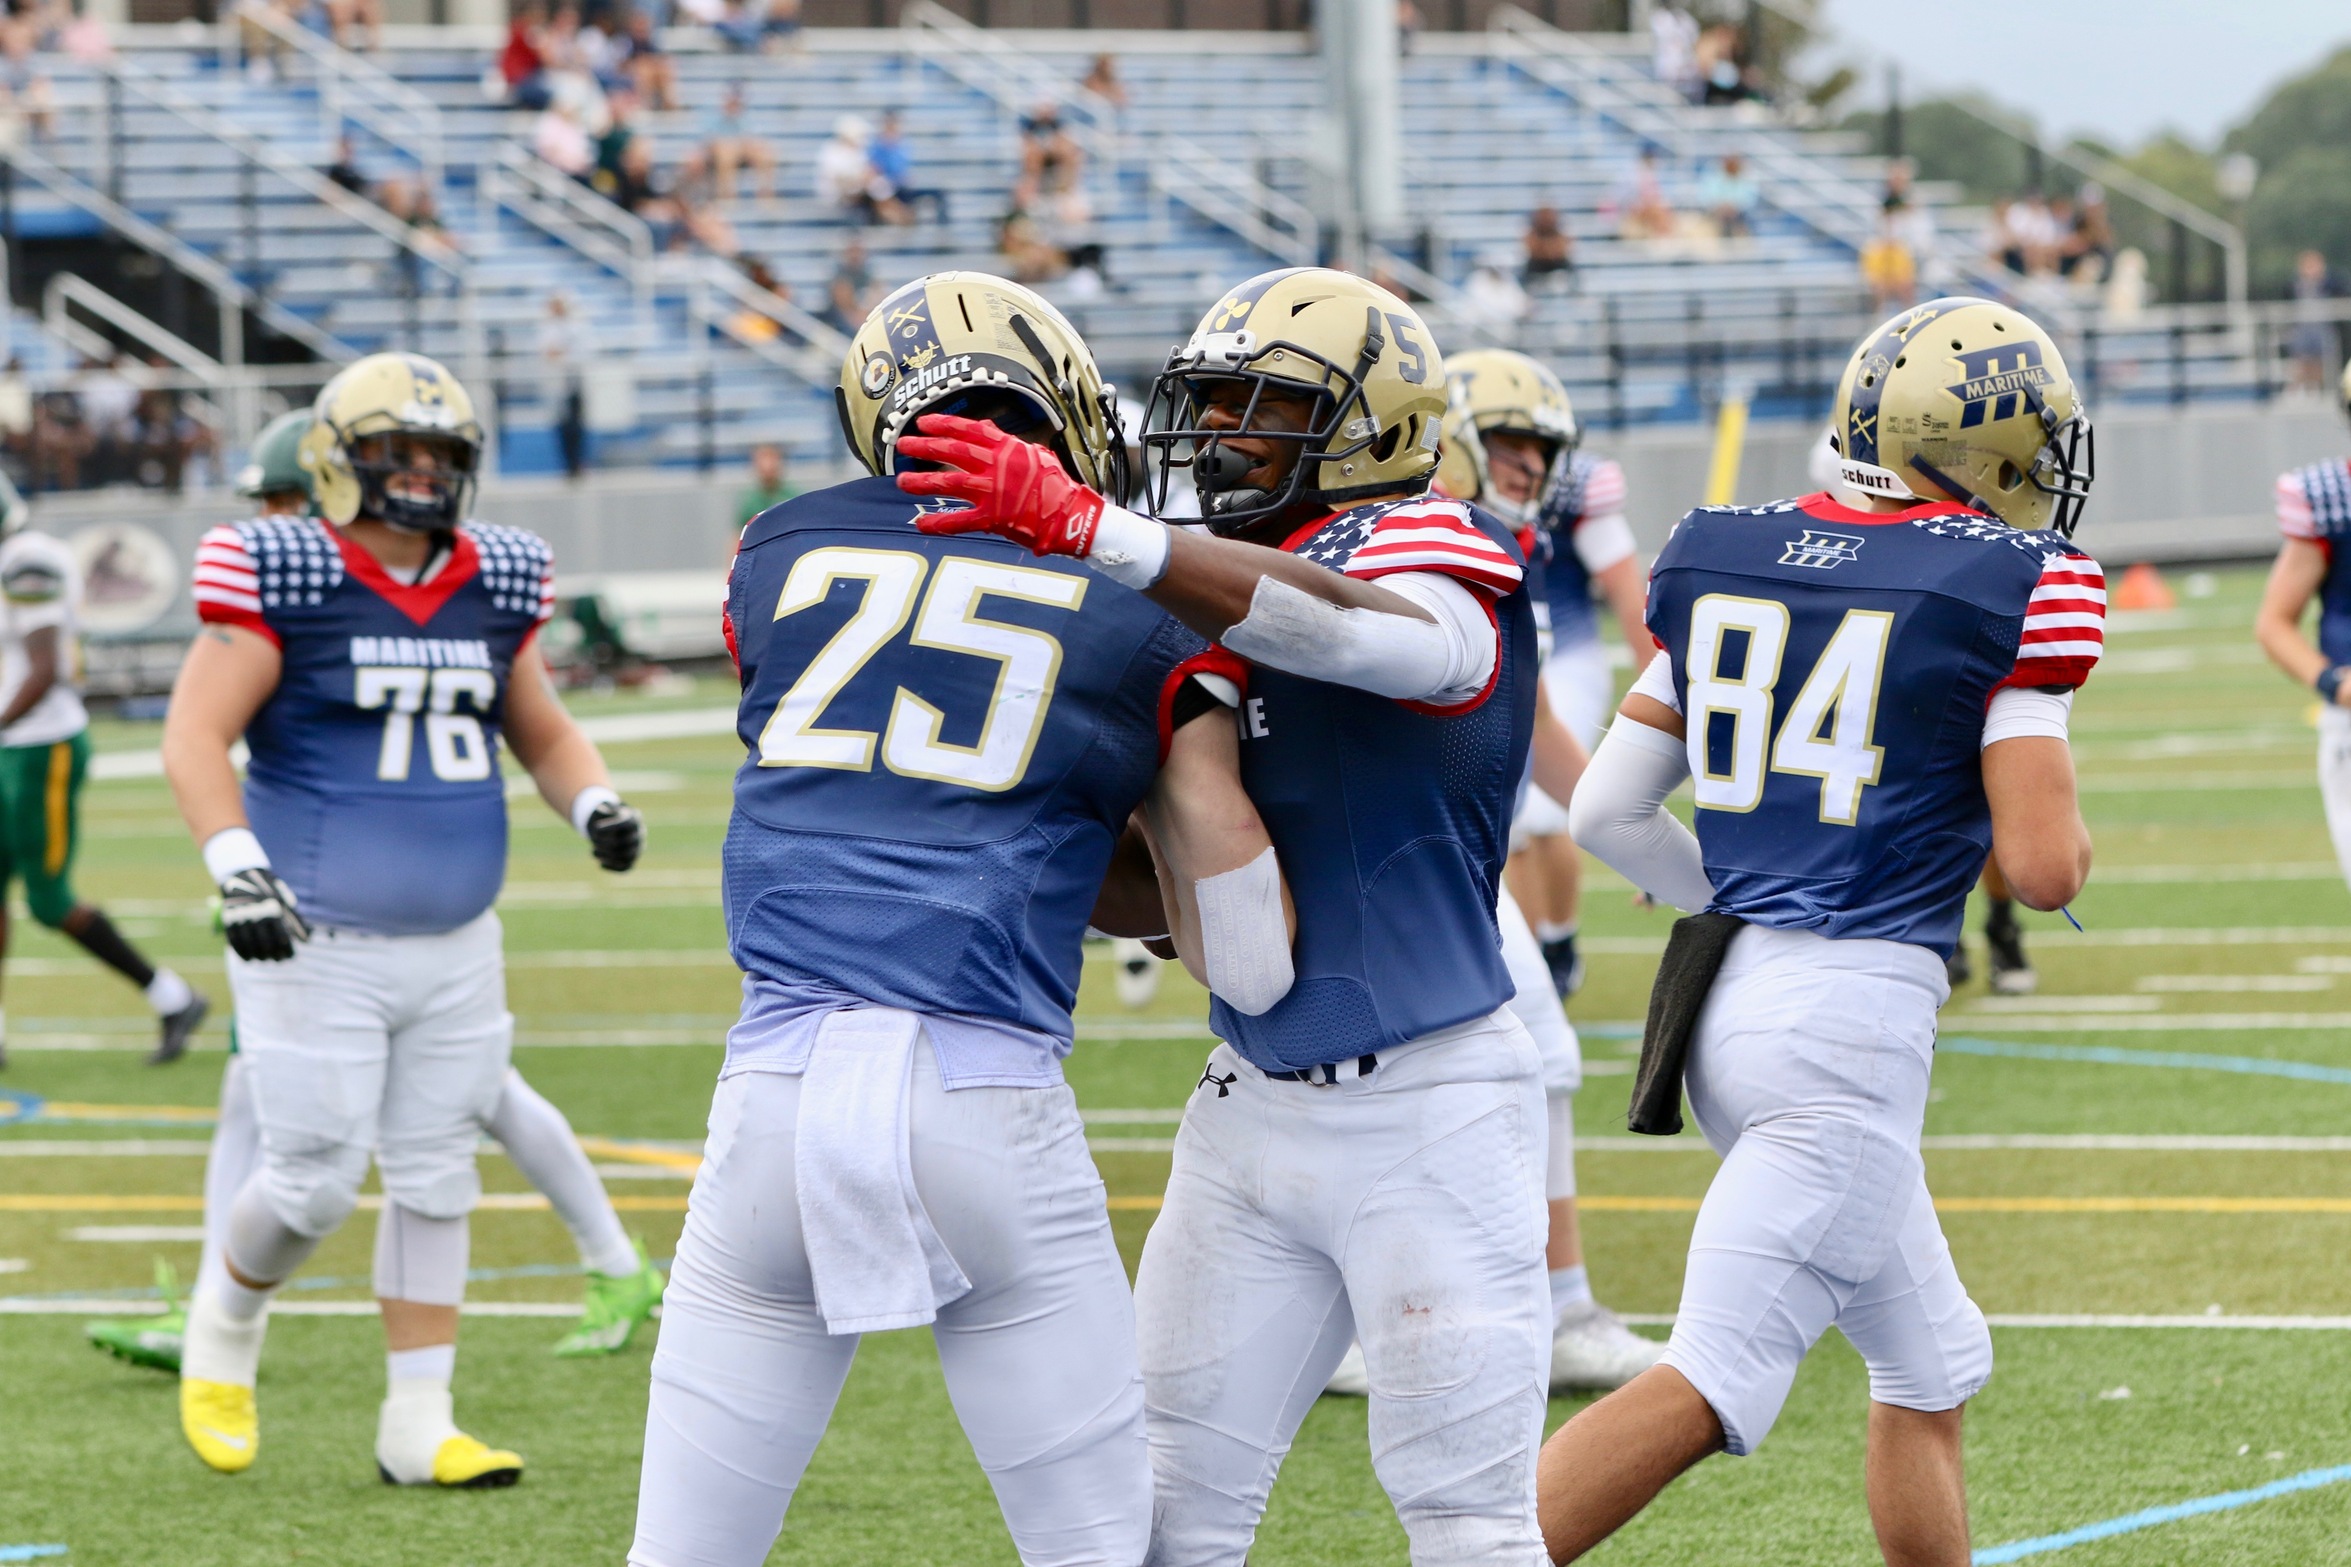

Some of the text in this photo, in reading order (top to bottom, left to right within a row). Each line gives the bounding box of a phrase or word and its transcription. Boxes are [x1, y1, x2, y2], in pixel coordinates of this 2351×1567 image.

[1384, 312, 1428, 385] 5
[894, 354, 972, 409] schutt
[1965, 368, 2046, 400] MARITIME
[1841, 467, 1891, 489] schutt
[1074, 504, 1097, 555] CUTTERS
[1801, 546, 1842, 557] MARITIME
[350, 636, 493, 669] MARITIME
[757, 546, 1090, 793] 25
[355, 666, 497, 782] 76
[1685, 592, 1896, 827] 84
